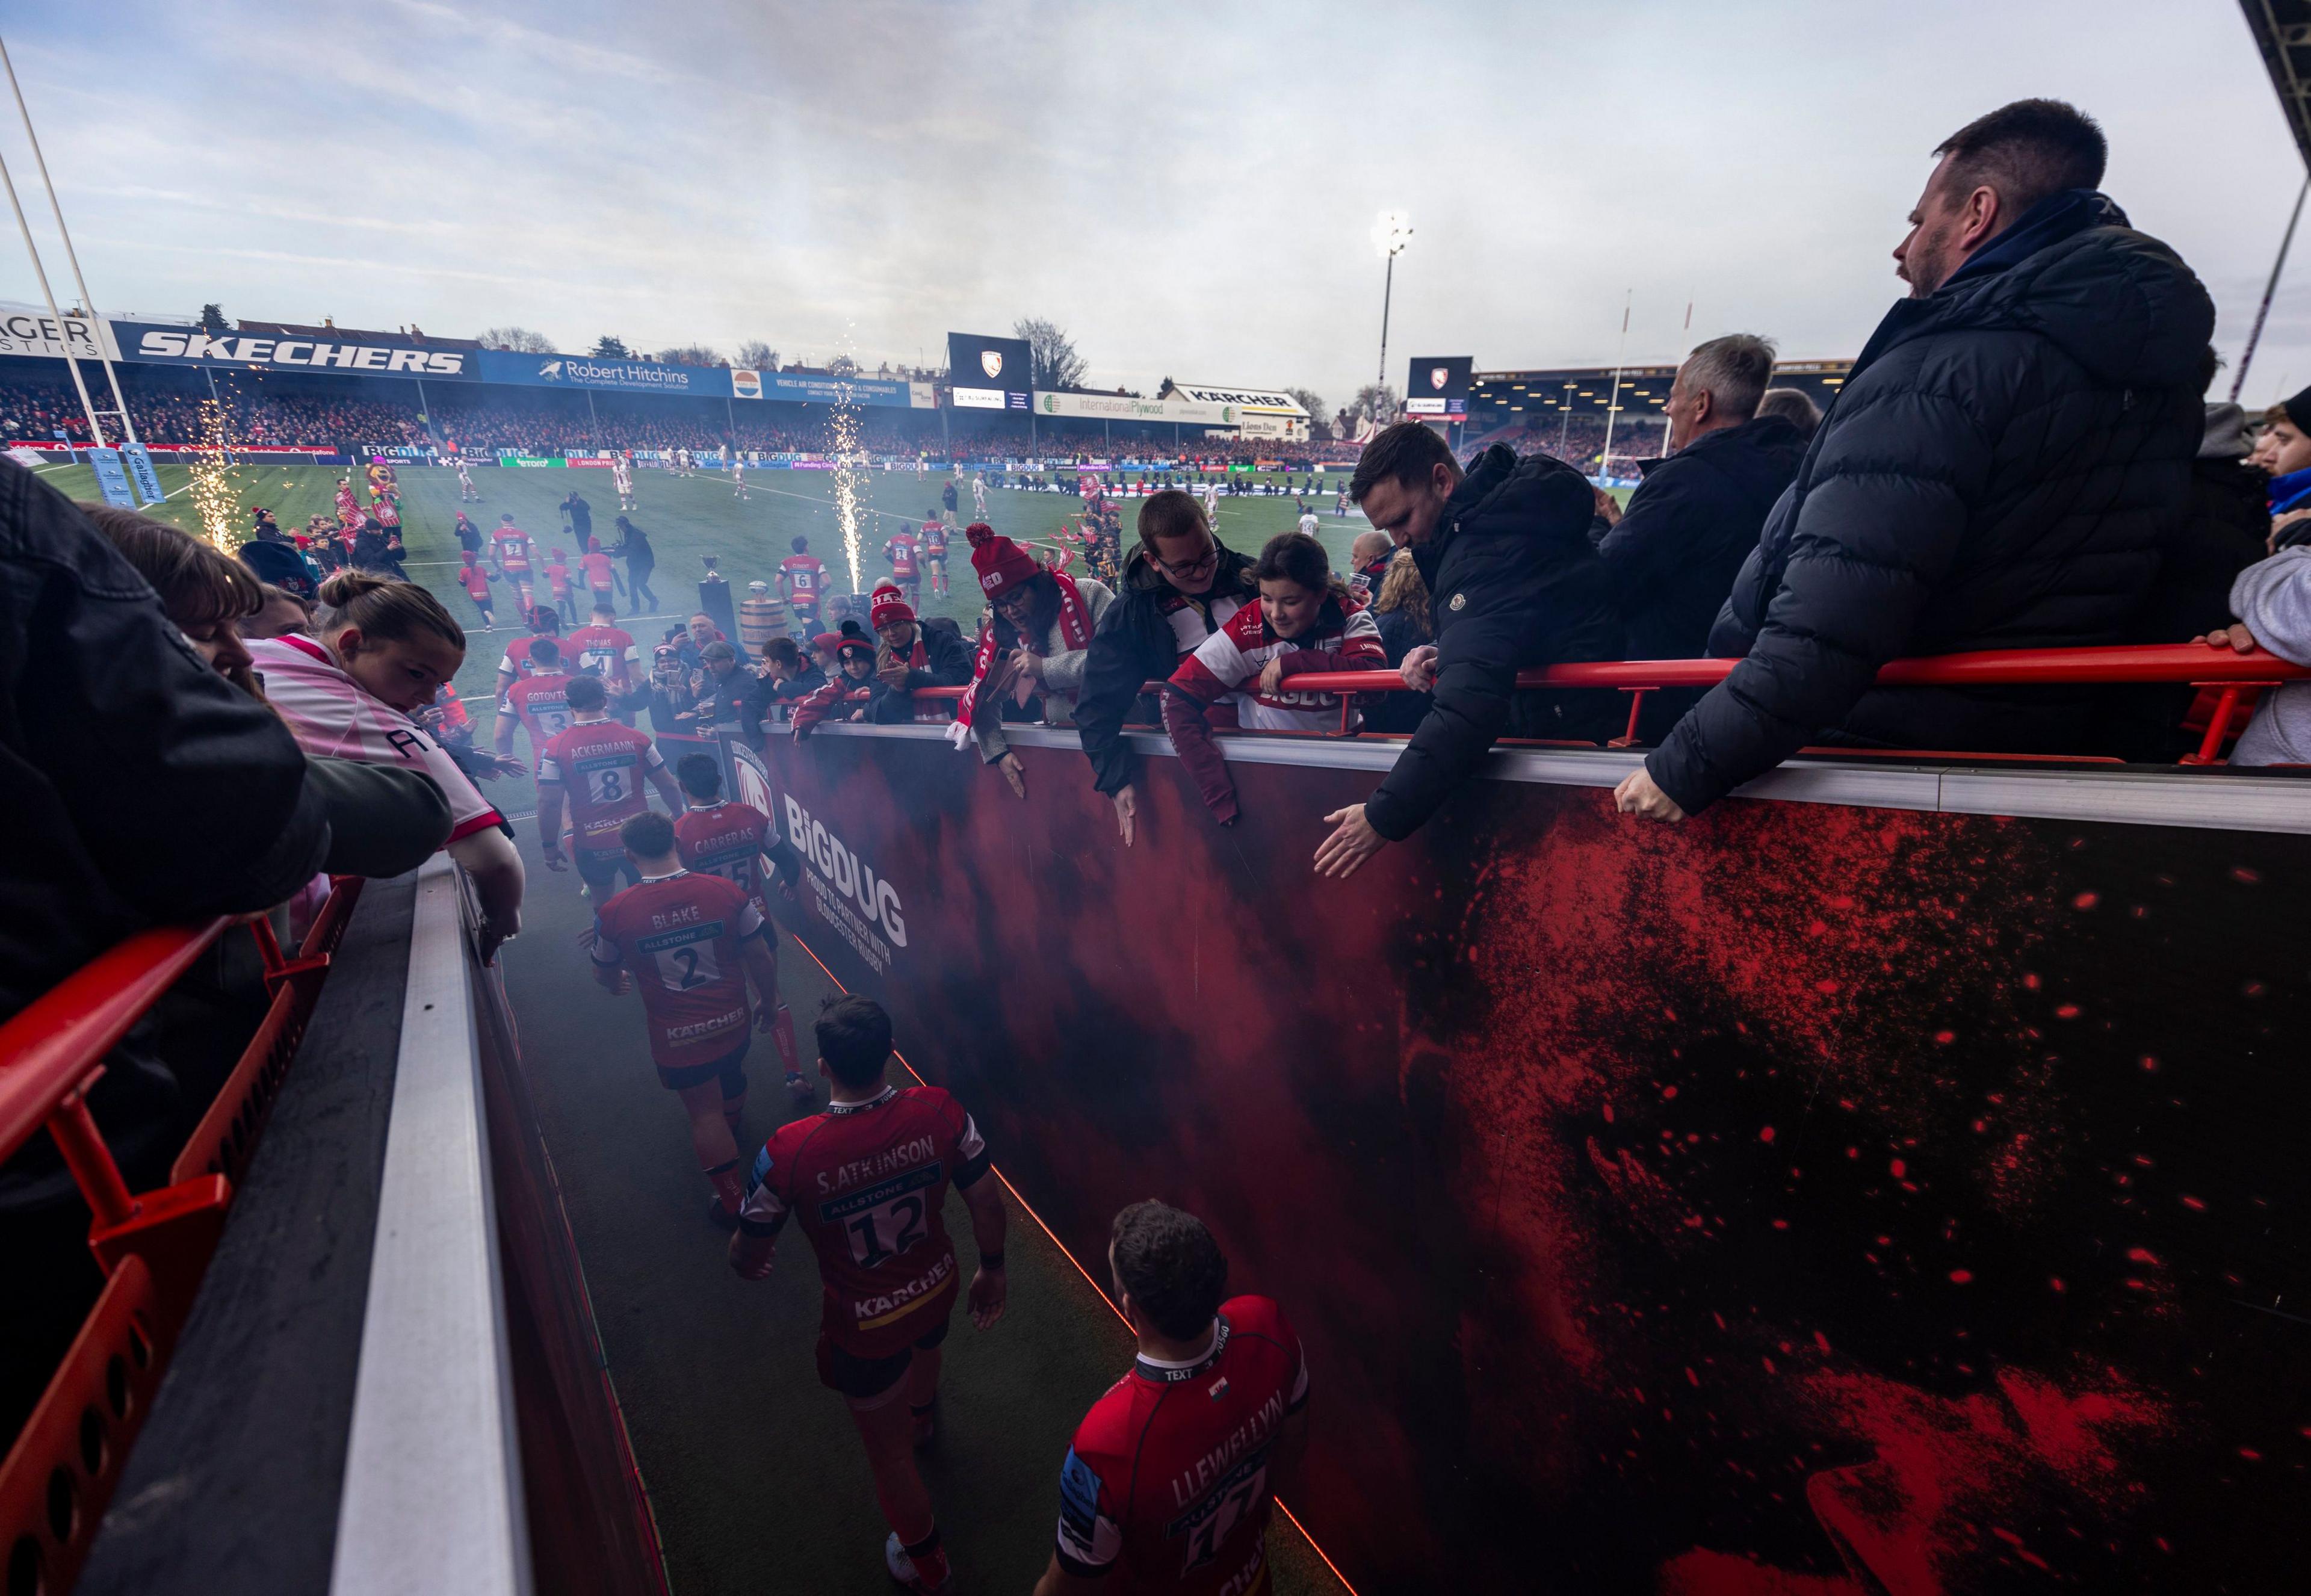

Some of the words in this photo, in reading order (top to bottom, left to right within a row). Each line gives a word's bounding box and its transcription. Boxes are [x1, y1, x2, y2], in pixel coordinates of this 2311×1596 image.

[0, 317, 92, 343] GER
[139, 332, 463, 374] SKECHERS
[566, 360, 624, 380] Robert
[627, 365, 688, 383] Hitchins
[584, 377, 617, 386] Complete
[619, 380, 662, 388] Development
[1242, 421, 1261, 430] Lions
[1264, 422, 1276, 431] Den
[134, 457, 156, 499] Gallagher
[509, 544, 517, 555] 7
[799, 575, 807, 587] 6
[527, 690, 567, 702] GOTOVTS
[551, 713, 566, 728] 3
[572, 740, 636, 759] ACKERMANN
[581, 759, 617, 770] ALLSTONE
[602, 770, 622, 800] 8
[695, 827, 754, 853] CARRERAS
[699, 852, 739, 867] ALLSTONE
[652, 905, 701, 930] BLAKE
[806, 867, 828, 900] PROUD
[826, 886, 836, 908] TO
[835, 894, 870, 941] PARTNER
[868, 929, 891, 965] WITH
[645, 932, 696, 949] ALLSTONE
[815, 895, 858, 951] GLOUCESTER
[857, 940, 883, 976] RUGBY
[673, 947, 707, 989] 2
[831, 1183, 903, 1215] ALLSTONE
[850, 1195, 925, 1268] 12
[1165, 1368, 1193, 1381] TEXT
[1172, 1389, 1282, 1509] LLEWELLYN
